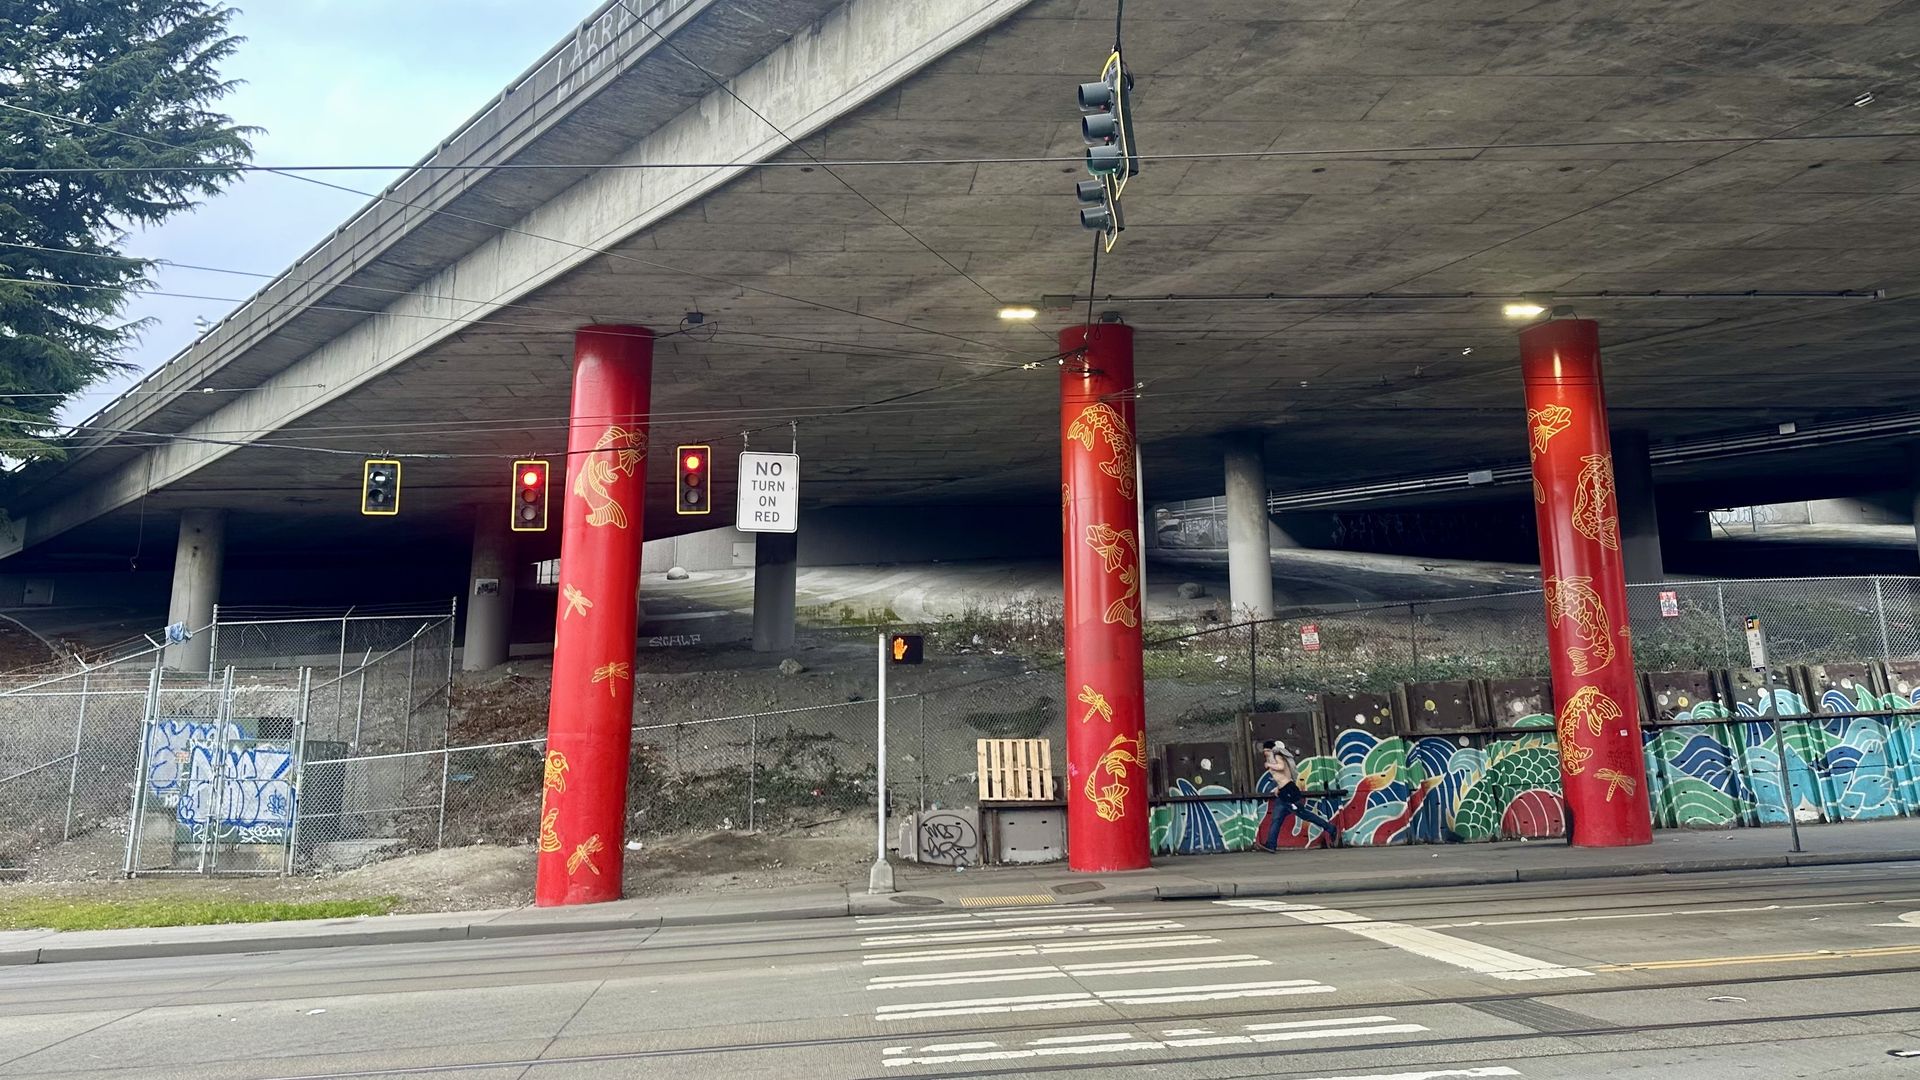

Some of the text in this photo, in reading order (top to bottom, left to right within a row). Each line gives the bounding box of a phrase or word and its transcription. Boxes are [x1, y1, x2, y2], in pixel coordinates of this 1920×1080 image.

[756, 461, 782, 476] NO
[752, 480, 785, 492] TURN
[759, 495, 776, 507] ON
[755, 511, 780, 522] RED
